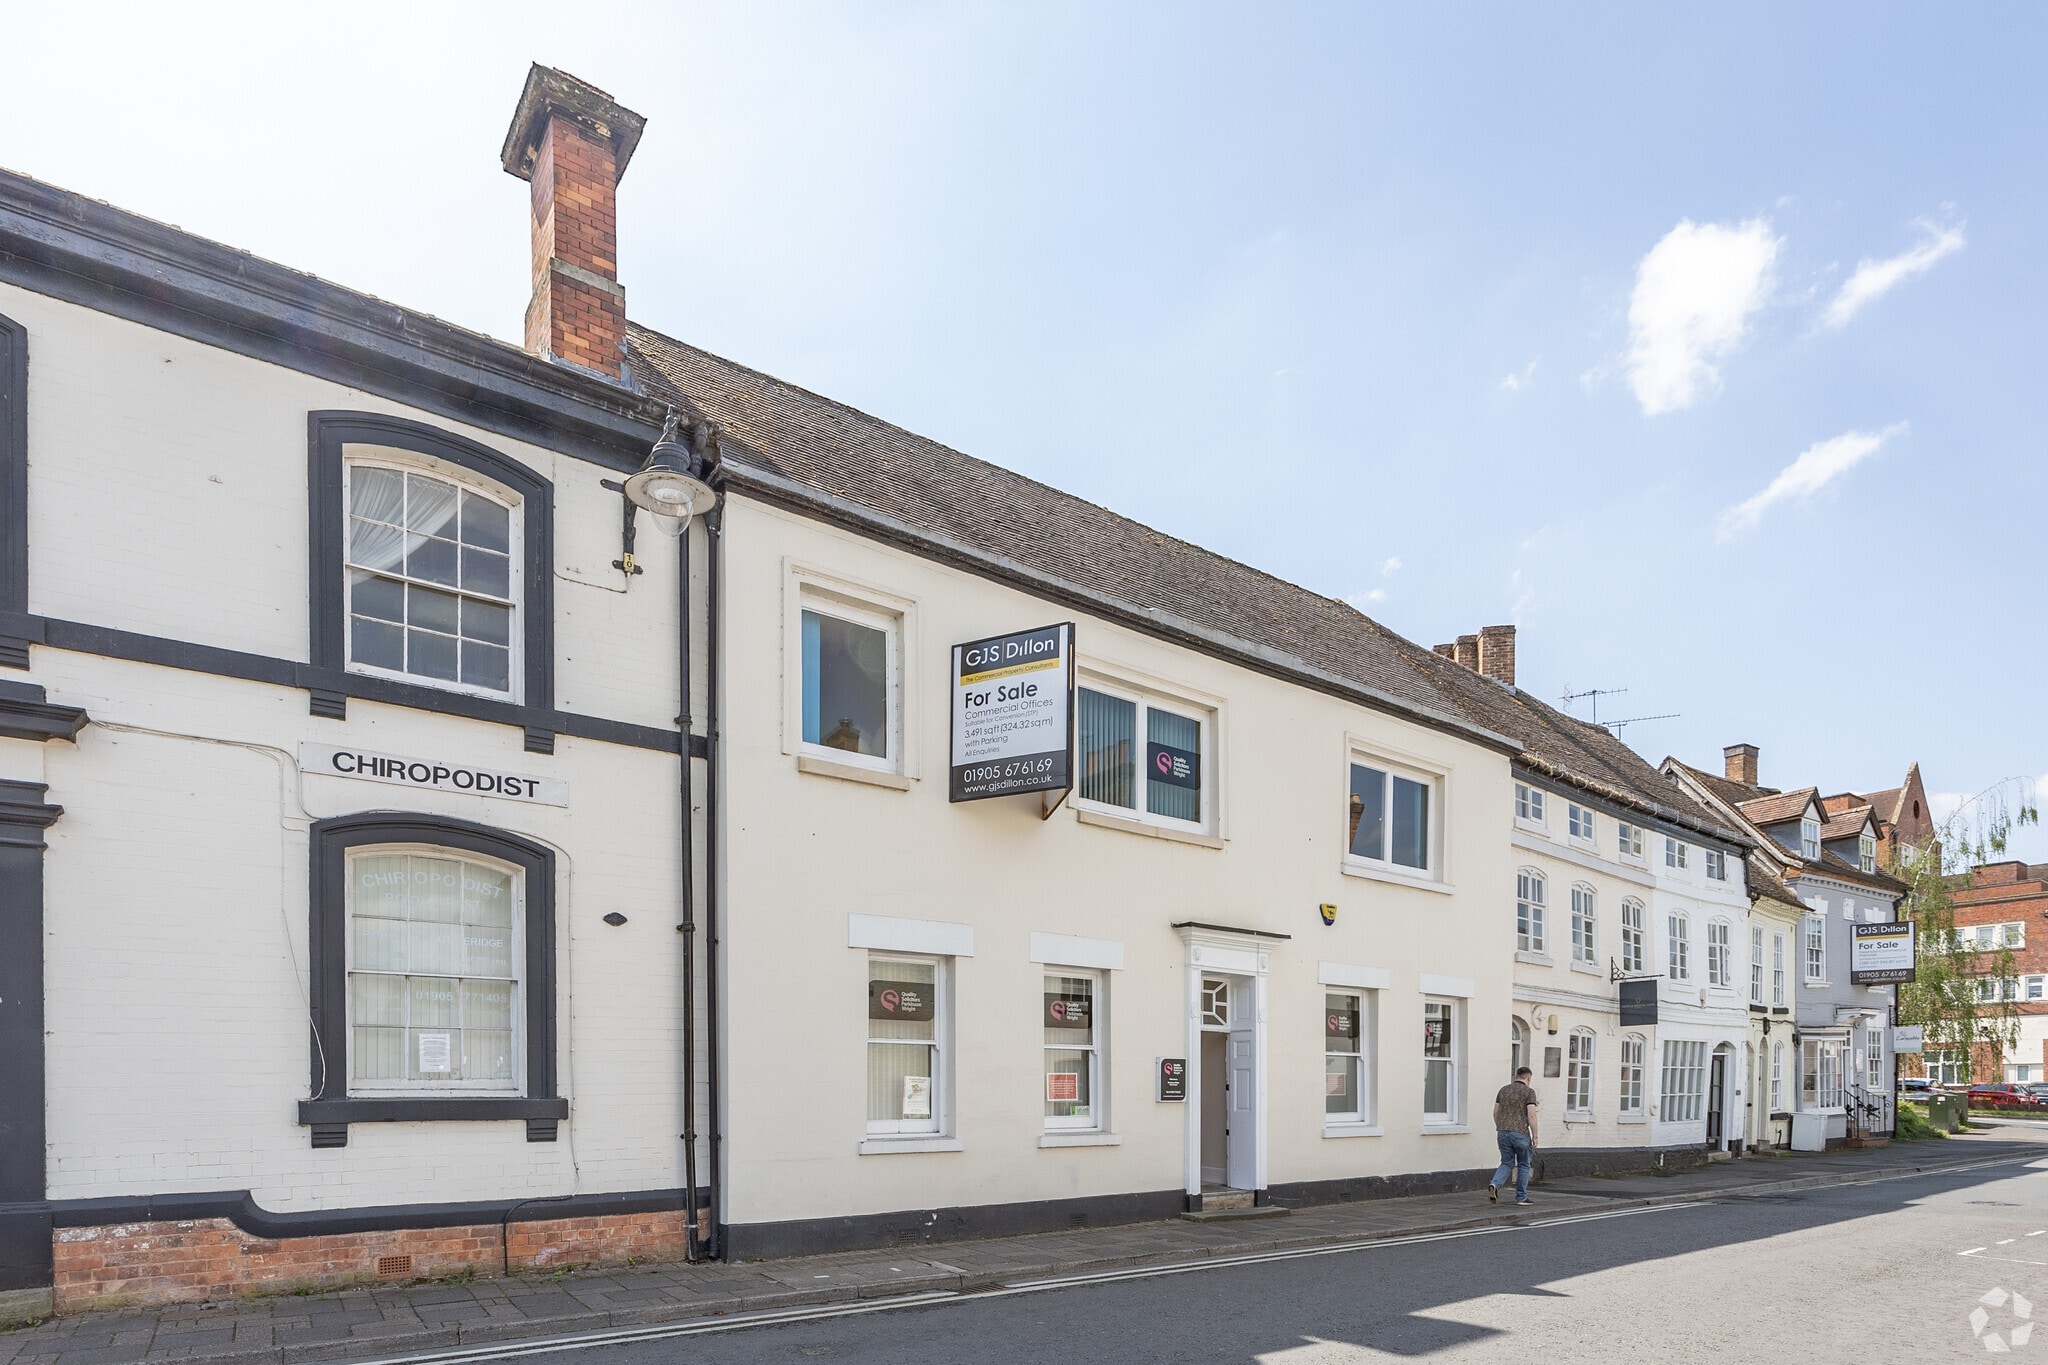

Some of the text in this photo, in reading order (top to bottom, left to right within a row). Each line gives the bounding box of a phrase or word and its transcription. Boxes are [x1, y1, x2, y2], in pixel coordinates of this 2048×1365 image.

[965, 638, 1054, 667] GJS Dillon
[974, 671, 1003, 682] Commercial
[1003, 667, 1024, 676] Property
[1024, 662, 1054, 671] Consultants
[965, 681, 1038, 709] For Sale
[964, 698, 1054, 720] Commercial Offices
[964, 718, 986, 728] Suitable
[964, 735, 1009, 748] with Parking
[964, 746, 1000, 758] All Enquiries
[332, 752, 540, 798] CHIROPODIST
[963, 765, 1001, 783] 01905
[964, 773, 1053, 794] www.gjsdillon.co.uk
[1858, 925, 1907, 935] GJS Dillon
[1858, 941, 1899, 950] For Sale
[1858, 971, 1880, 979] 01905
[416, 990, 454, 1002] 01905
